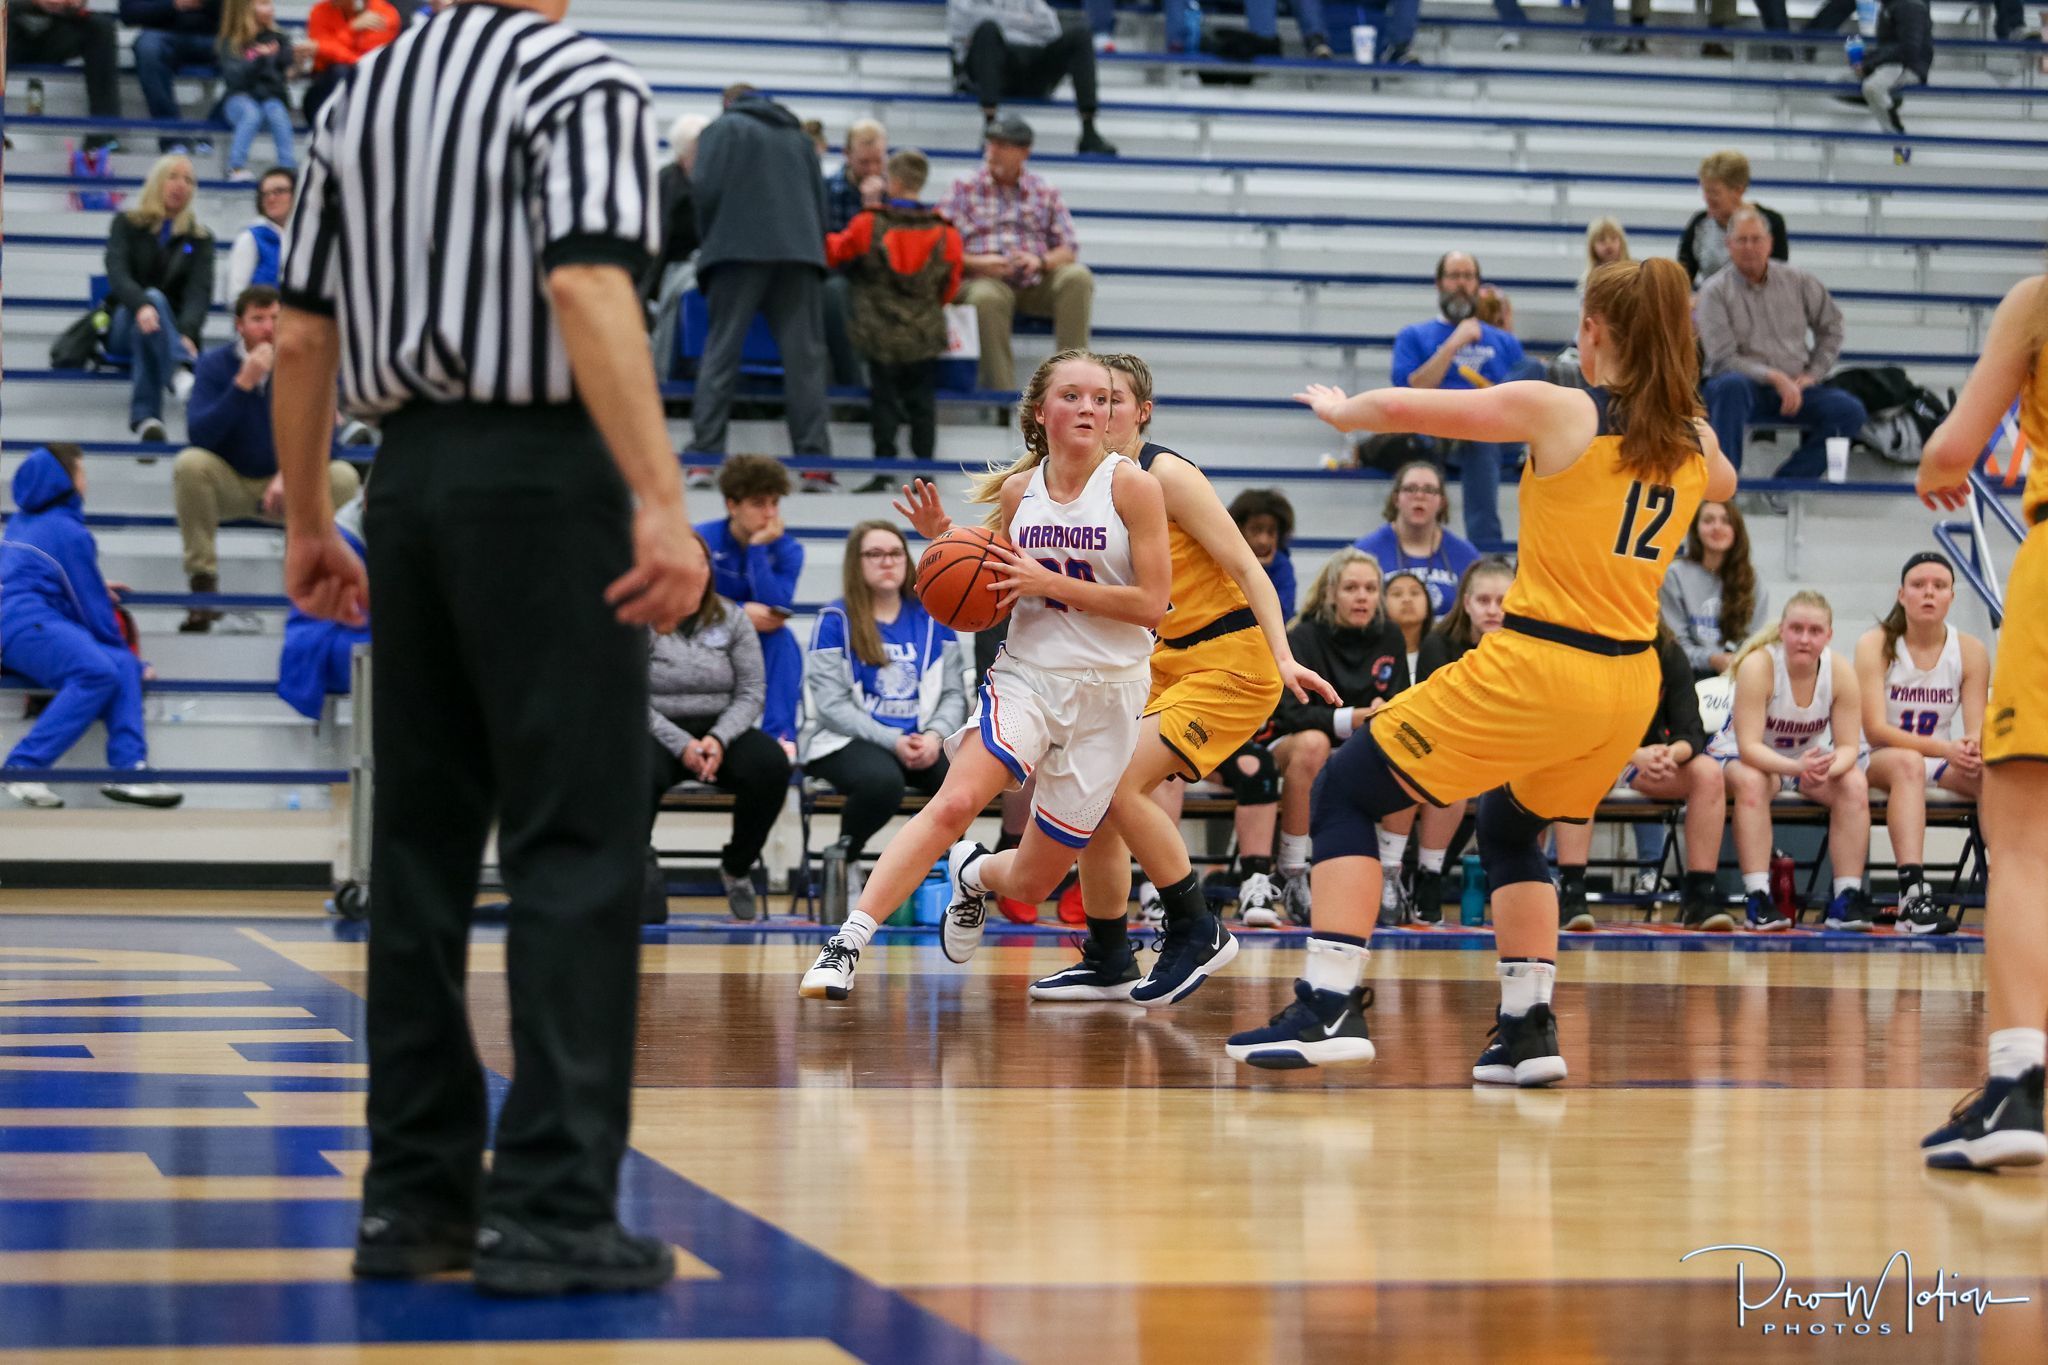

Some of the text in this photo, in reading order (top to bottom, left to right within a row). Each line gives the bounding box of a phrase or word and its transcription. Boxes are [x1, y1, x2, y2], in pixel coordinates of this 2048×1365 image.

[1612, 480, 1675, 561] 12
[1019, 526, 1107, 550] WARRIORS
[1890, 685, 1954, 704] WARRIORS
[1899, 709, 1939, 736] 10
